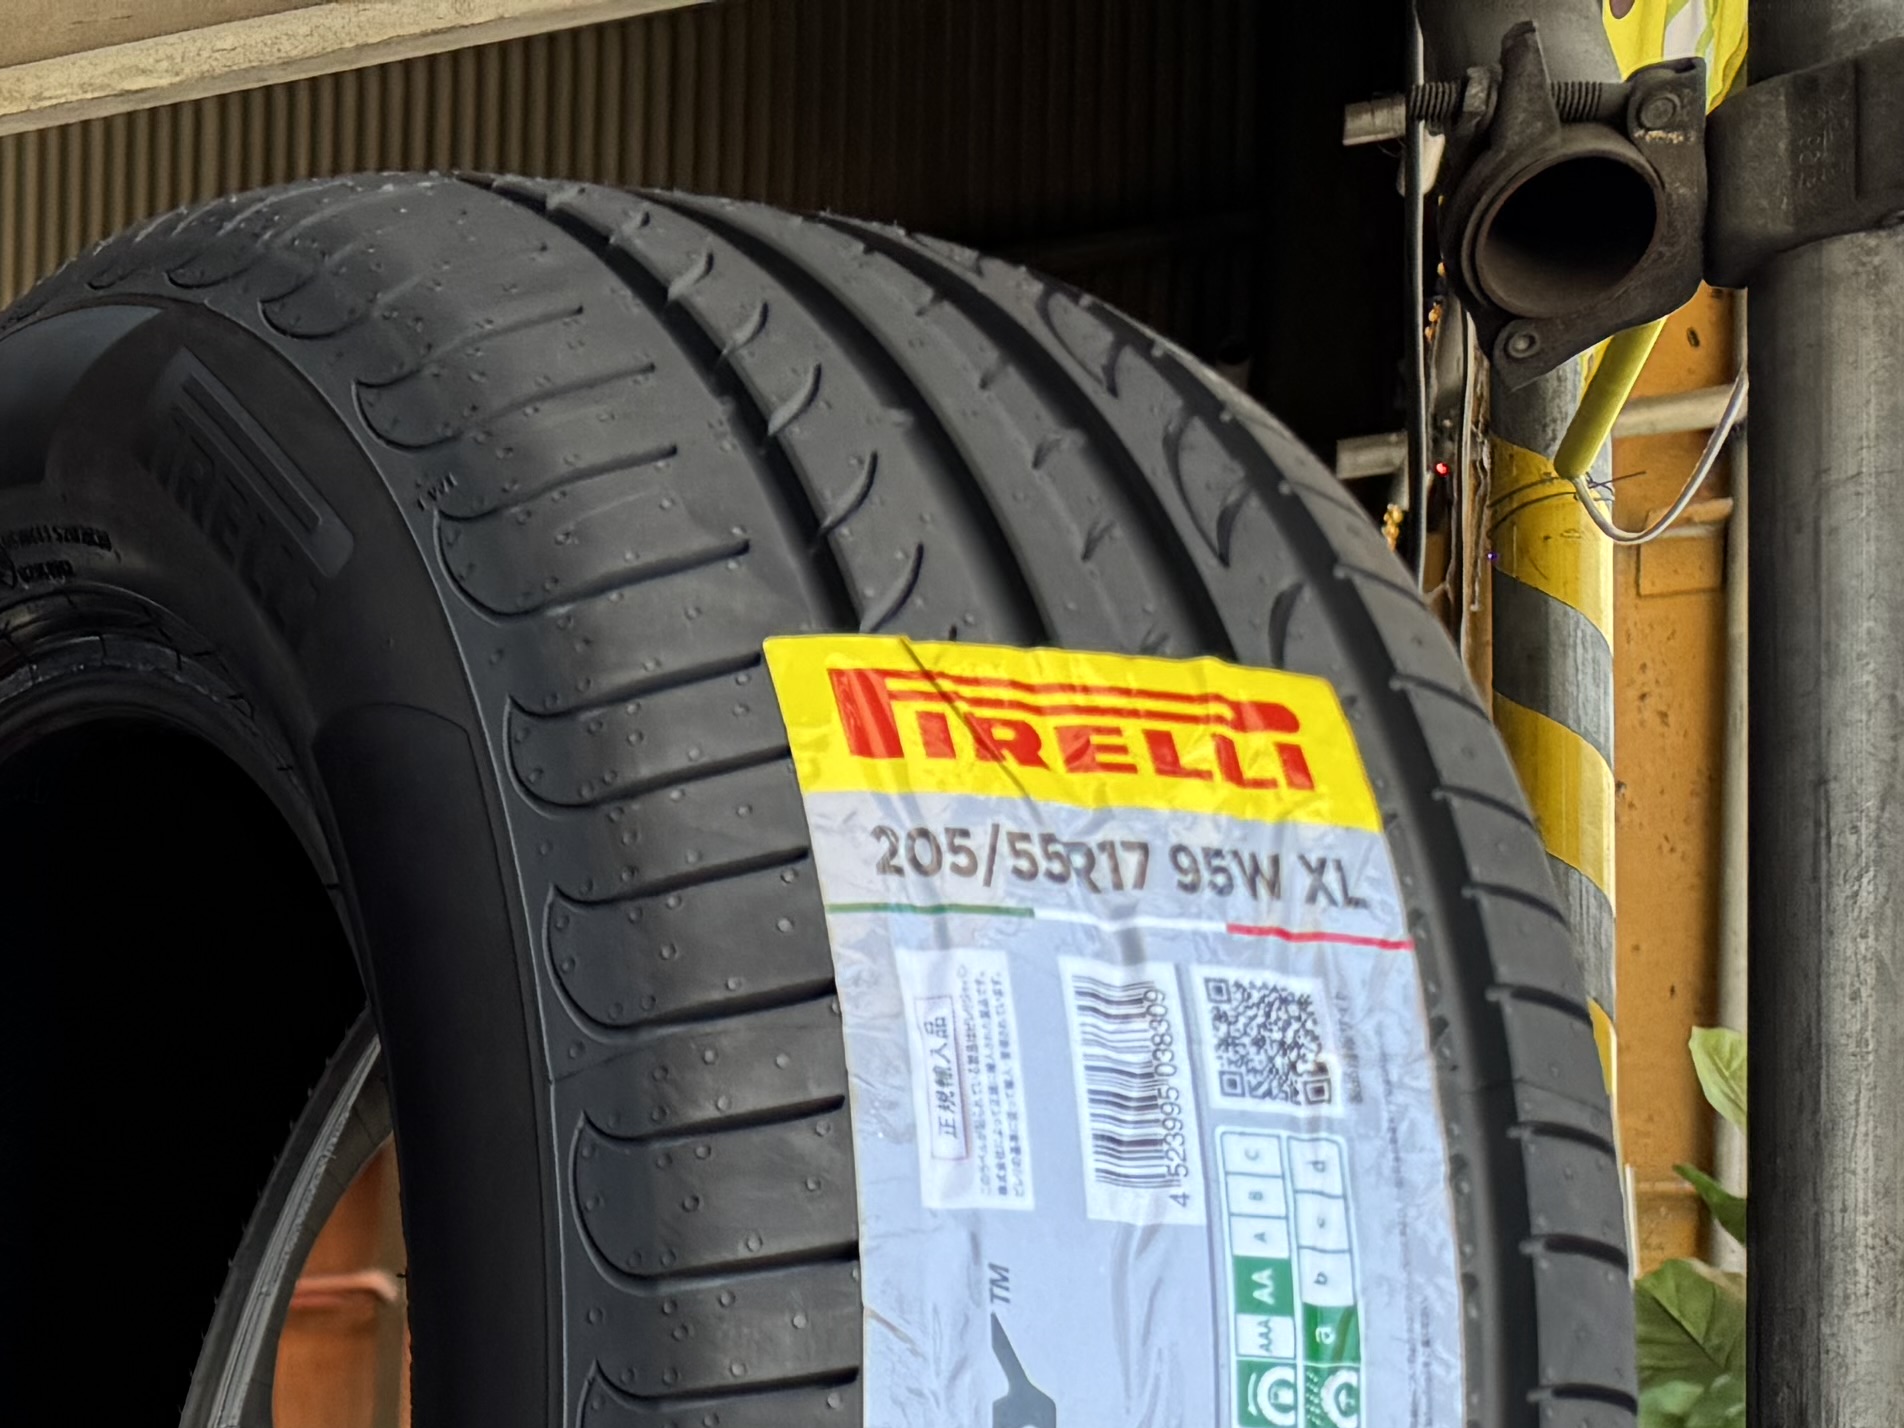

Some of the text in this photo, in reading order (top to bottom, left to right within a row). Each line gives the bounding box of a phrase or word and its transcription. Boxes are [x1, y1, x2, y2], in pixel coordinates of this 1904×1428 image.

[827, 668, 1317, 791] PIRELLI
[870, 823, 1370, 910] 205/55R17 95W XL
[923, 1015, 958, 1139] 正規輸入品
[1143, 989, 1190, 1208] 4 523995 038309
[1251, 1268, 1274, 1305] AA
[1315, 1326, 1334, 1344] a
